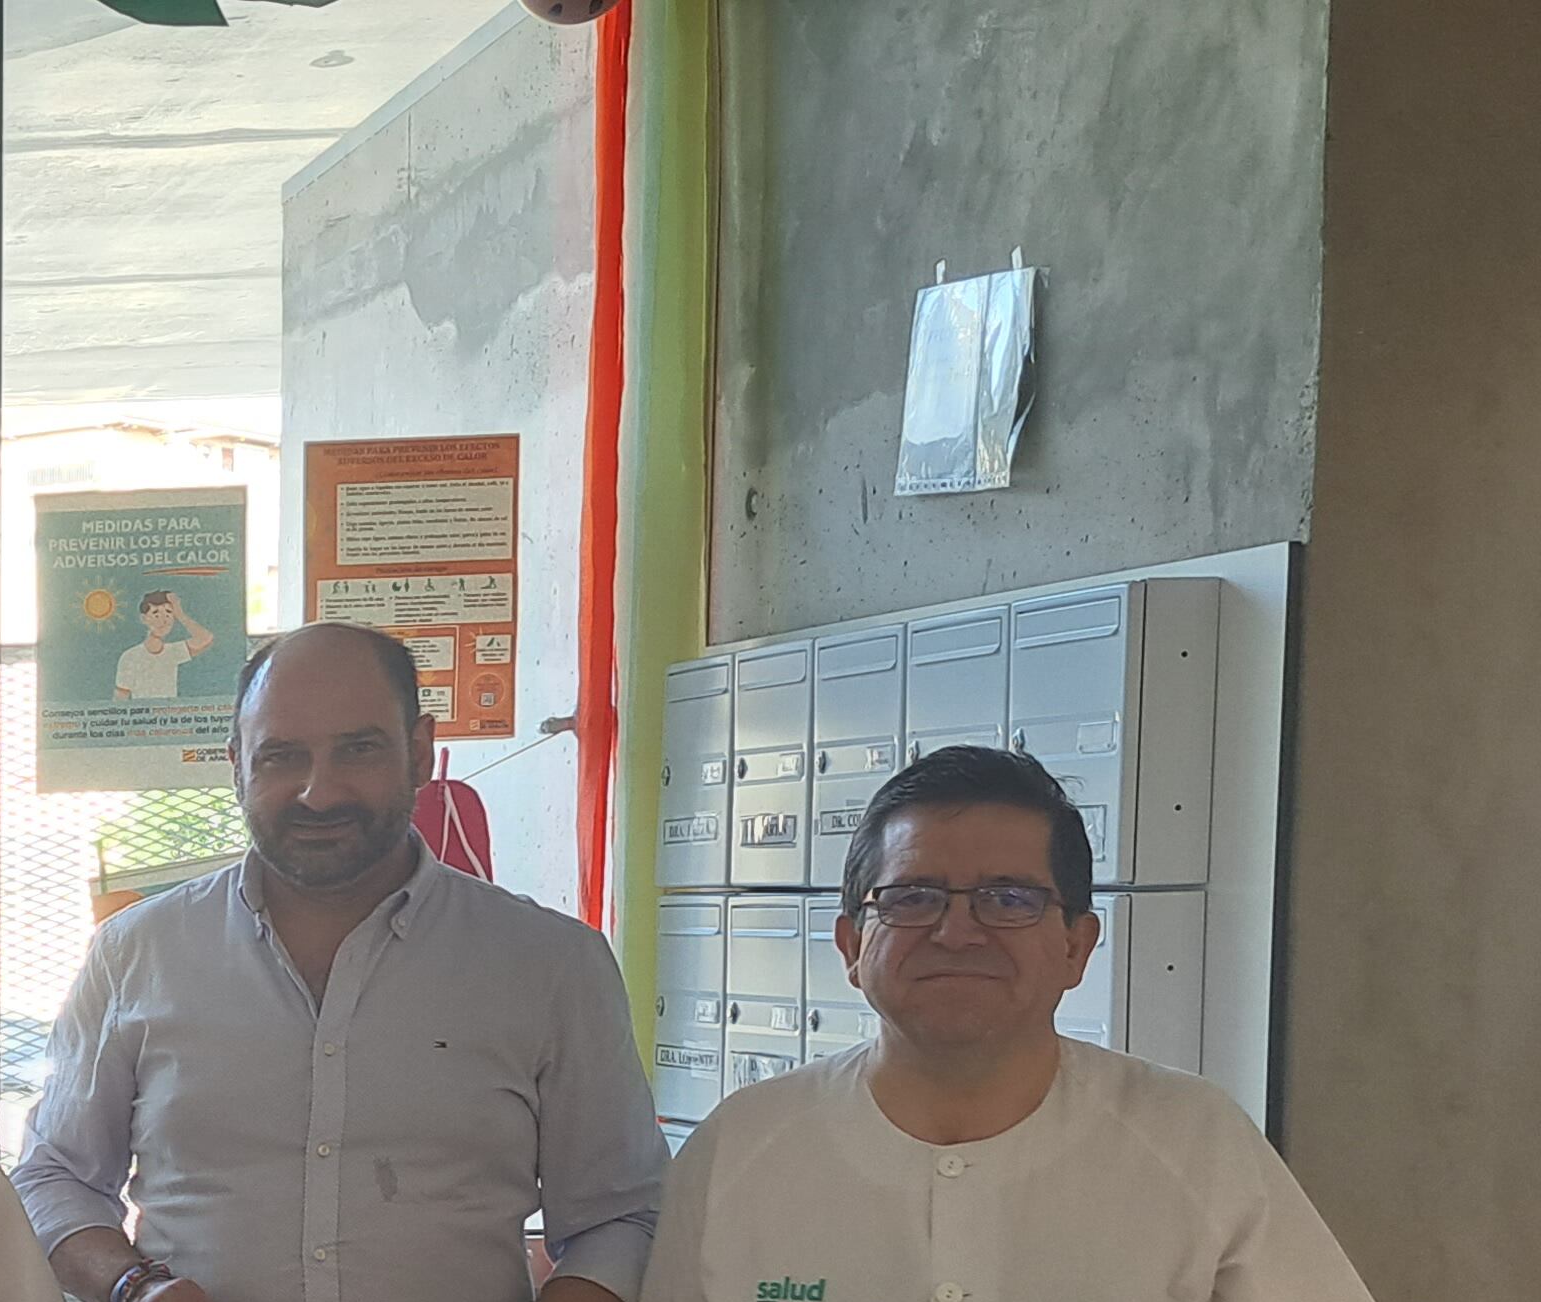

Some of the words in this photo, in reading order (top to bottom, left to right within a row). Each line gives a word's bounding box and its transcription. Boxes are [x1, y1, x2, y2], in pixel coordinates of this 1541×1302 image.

[82, 519, 153, 533] MEDIDAS
[158, 516, 201, 530] PARA
[49, 537, 125, 552] PREVENIR
[130, 535, 161, 549] LOS
[165, 532, 235, 547] EFECTOS
[53, 553, 138, 568] ADVERSOS
[143, 551, 173, 565] DEL
[177, 549, 230, 564] CALOR
[42, 709, 85, 718] Consejos
[87, 707, 127, 716] sencillos
[130, 707, 150, 716] para
[89, 719, 118, 727] cuidar
[132, 717, 157, 725] salud
[170, 716, 178, 724] la
[181, 715, 192, 723] de
[194, 715, 207, 723] los
[52, 730, 87, 739] durante
[90, 730, 103, 738] los
[196, 726, 209, 734] del
[211, 725, 229, 734] año
[757, 1276, 826, 1302] salud
